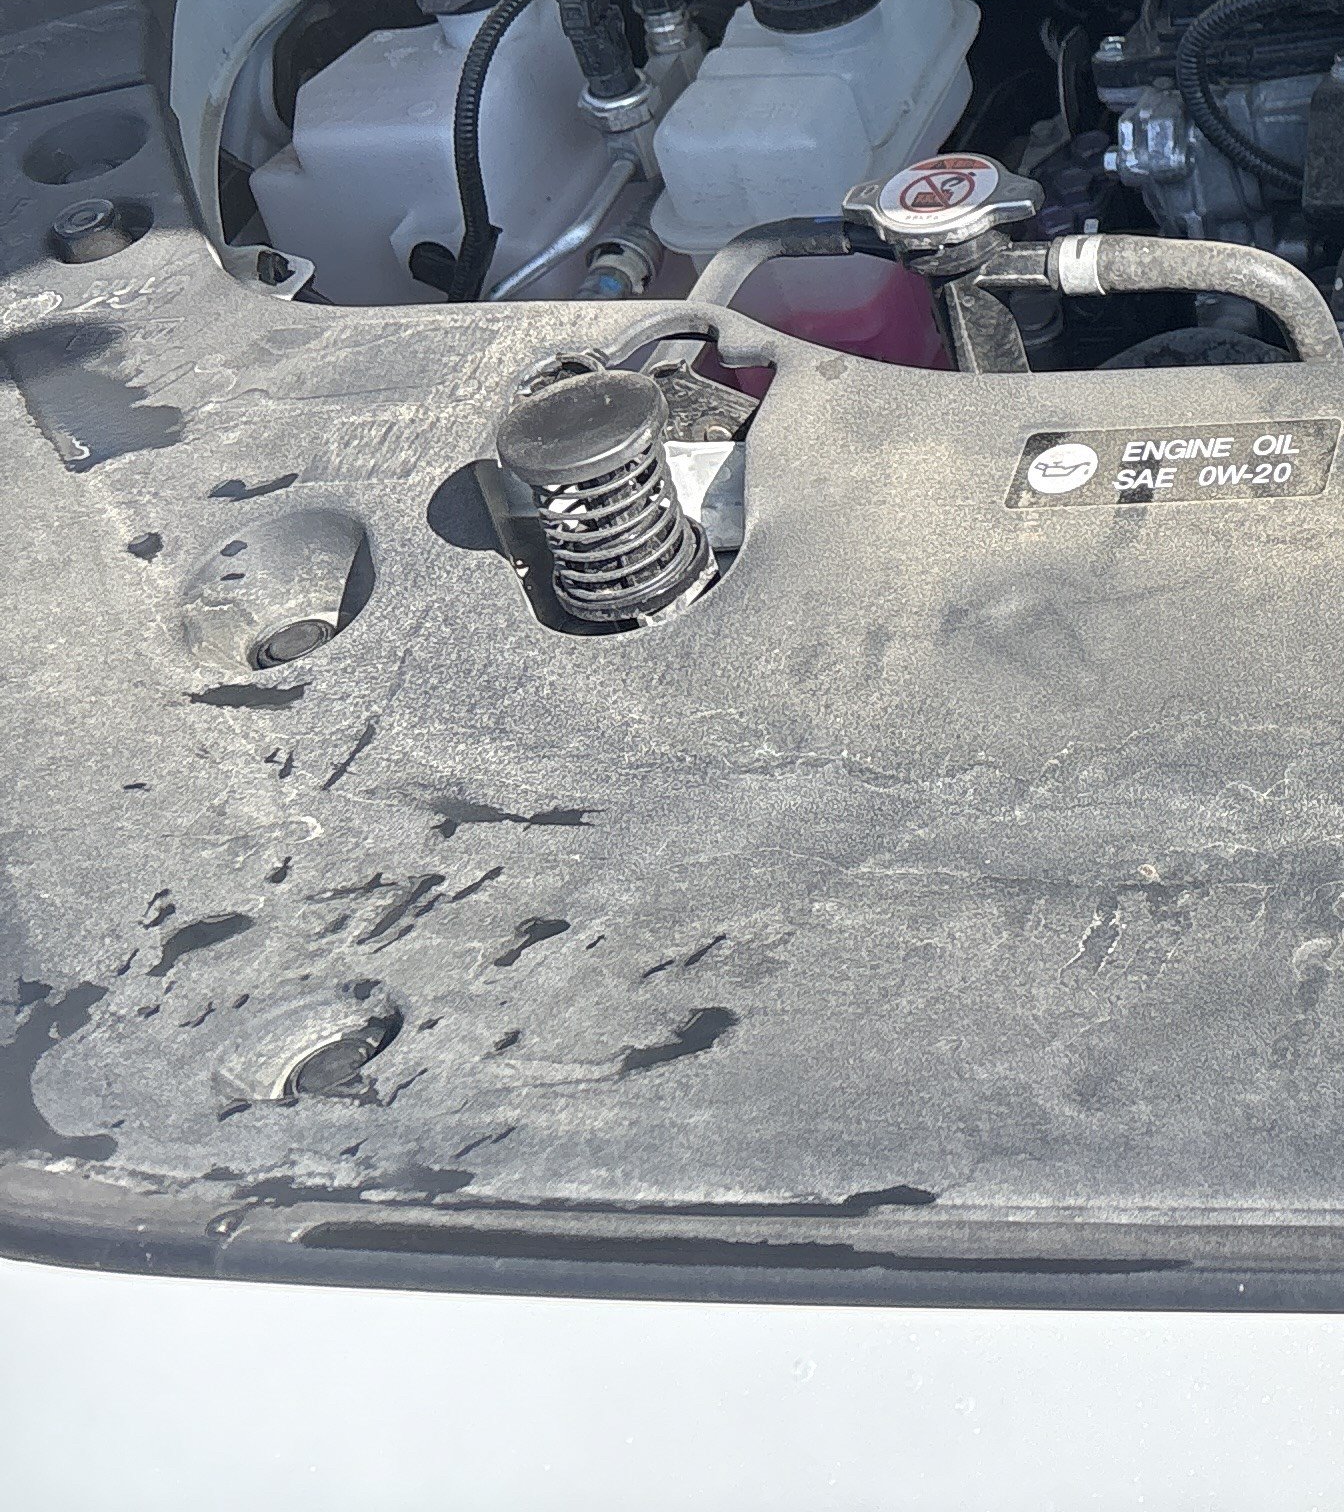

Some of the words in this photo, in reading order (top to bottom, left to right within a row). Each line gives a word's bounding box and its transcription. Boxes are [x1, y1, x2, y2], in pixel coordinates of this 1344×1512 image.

[1121, 437, 1235, 462] ENGINE
[1252, 434, 1300, 456] OIL
[1112, 467, 1178, 490] SAE
[1198, 462, 1293, 487] 0W-20
